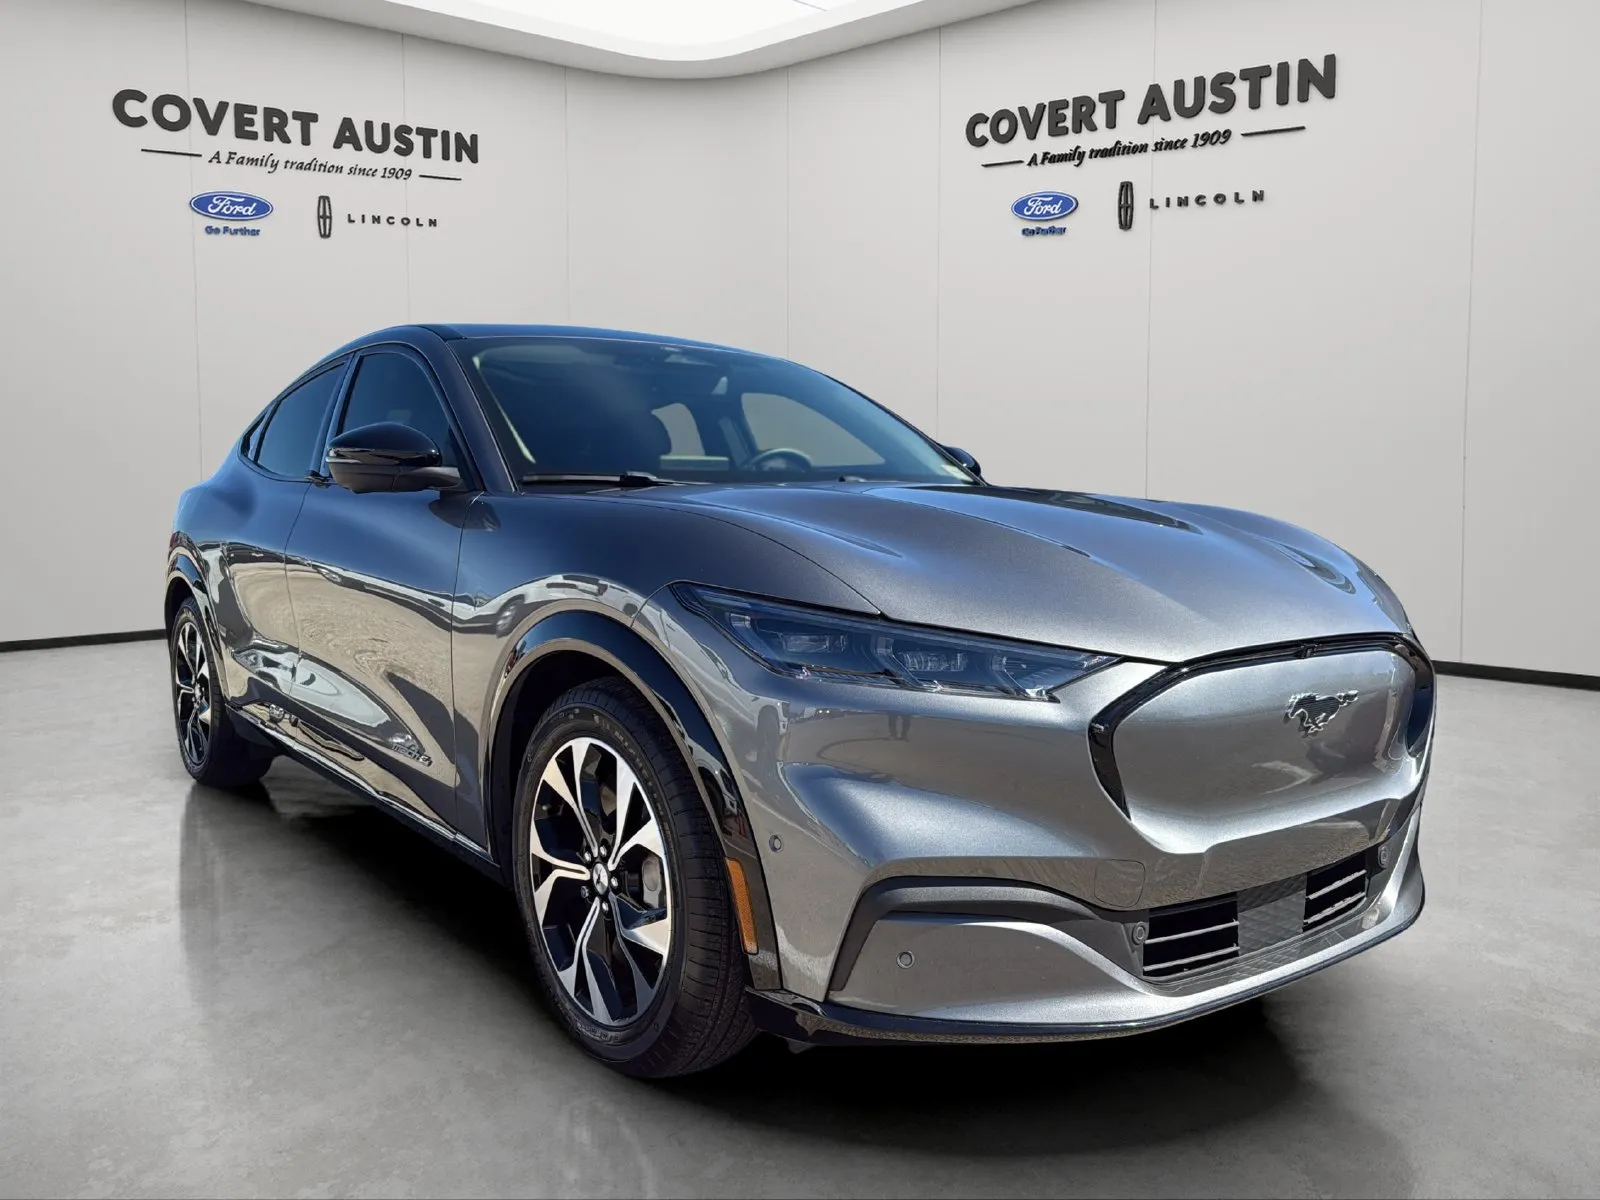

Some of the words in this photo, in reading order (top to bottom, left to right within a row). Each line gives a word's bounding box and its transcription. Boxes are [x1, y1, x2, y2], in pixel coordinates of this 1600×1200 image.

[965, 89, 1126, 148] COVERT
[1137, 54, 1337, 126] AUSTIN
[112, 89, 318, 147] COVERT
[333, 117, 479, 164] AUSTIN
[1026, 153, 1039, 168] A
[1039, 145, 1087, 168] Family
[1088, 140, 1150, 160] tradition
[1151, 137, 1188, 153] since
[1190, 128, 1233, 149] 1909
[208, 150, 222, 165] A
[225, 151, 280, 175] Family
[283, 157, 344, 175] tradition
[347, 163, 379, 178] since
[380, 166, 413, 181] 1909
[207, 195, 257, 217] Ford
[1022, 195, 1064, 217] Ford
[1149, 189, 1265, 211] LINCOLN
[204, 225, 221, 236] Go
[222, 225, 261, 237] Further
[347, 213, 438, 228] LINCOLN
